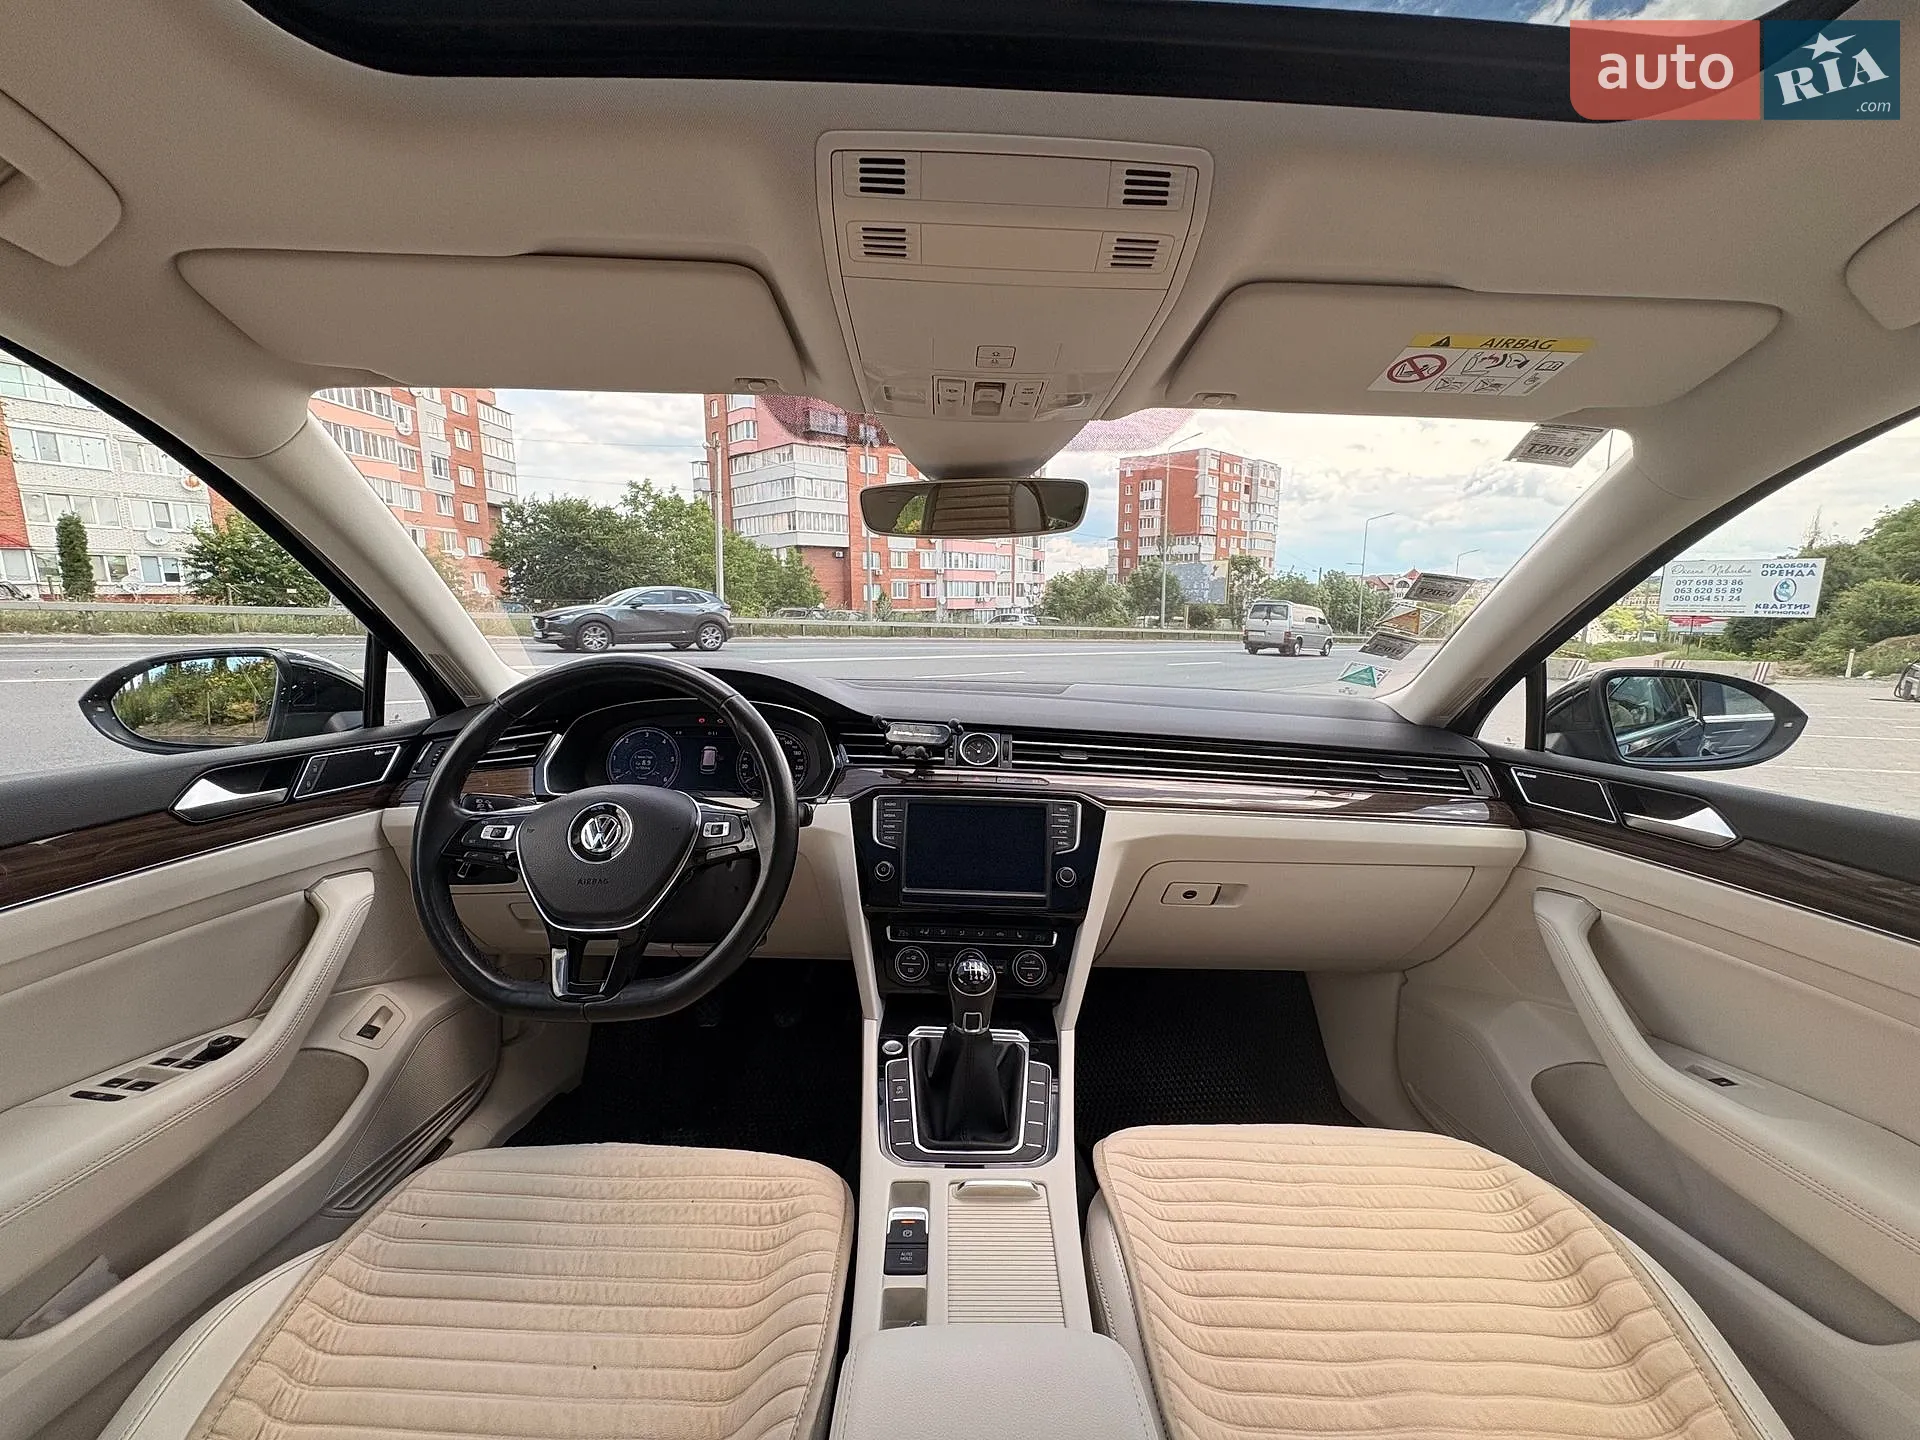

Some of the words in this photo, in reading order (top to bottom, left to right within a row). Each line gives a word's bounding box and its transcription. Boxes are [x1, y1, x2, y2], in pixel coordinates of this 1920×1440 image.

[1479, 337, 1559, 350] AIRBAG
[1526, 443, 1579, 457] T2018
[1760, 569, 1816, 577] ОРЕНДА
[576, 878, 609, 887] AIRBAG
